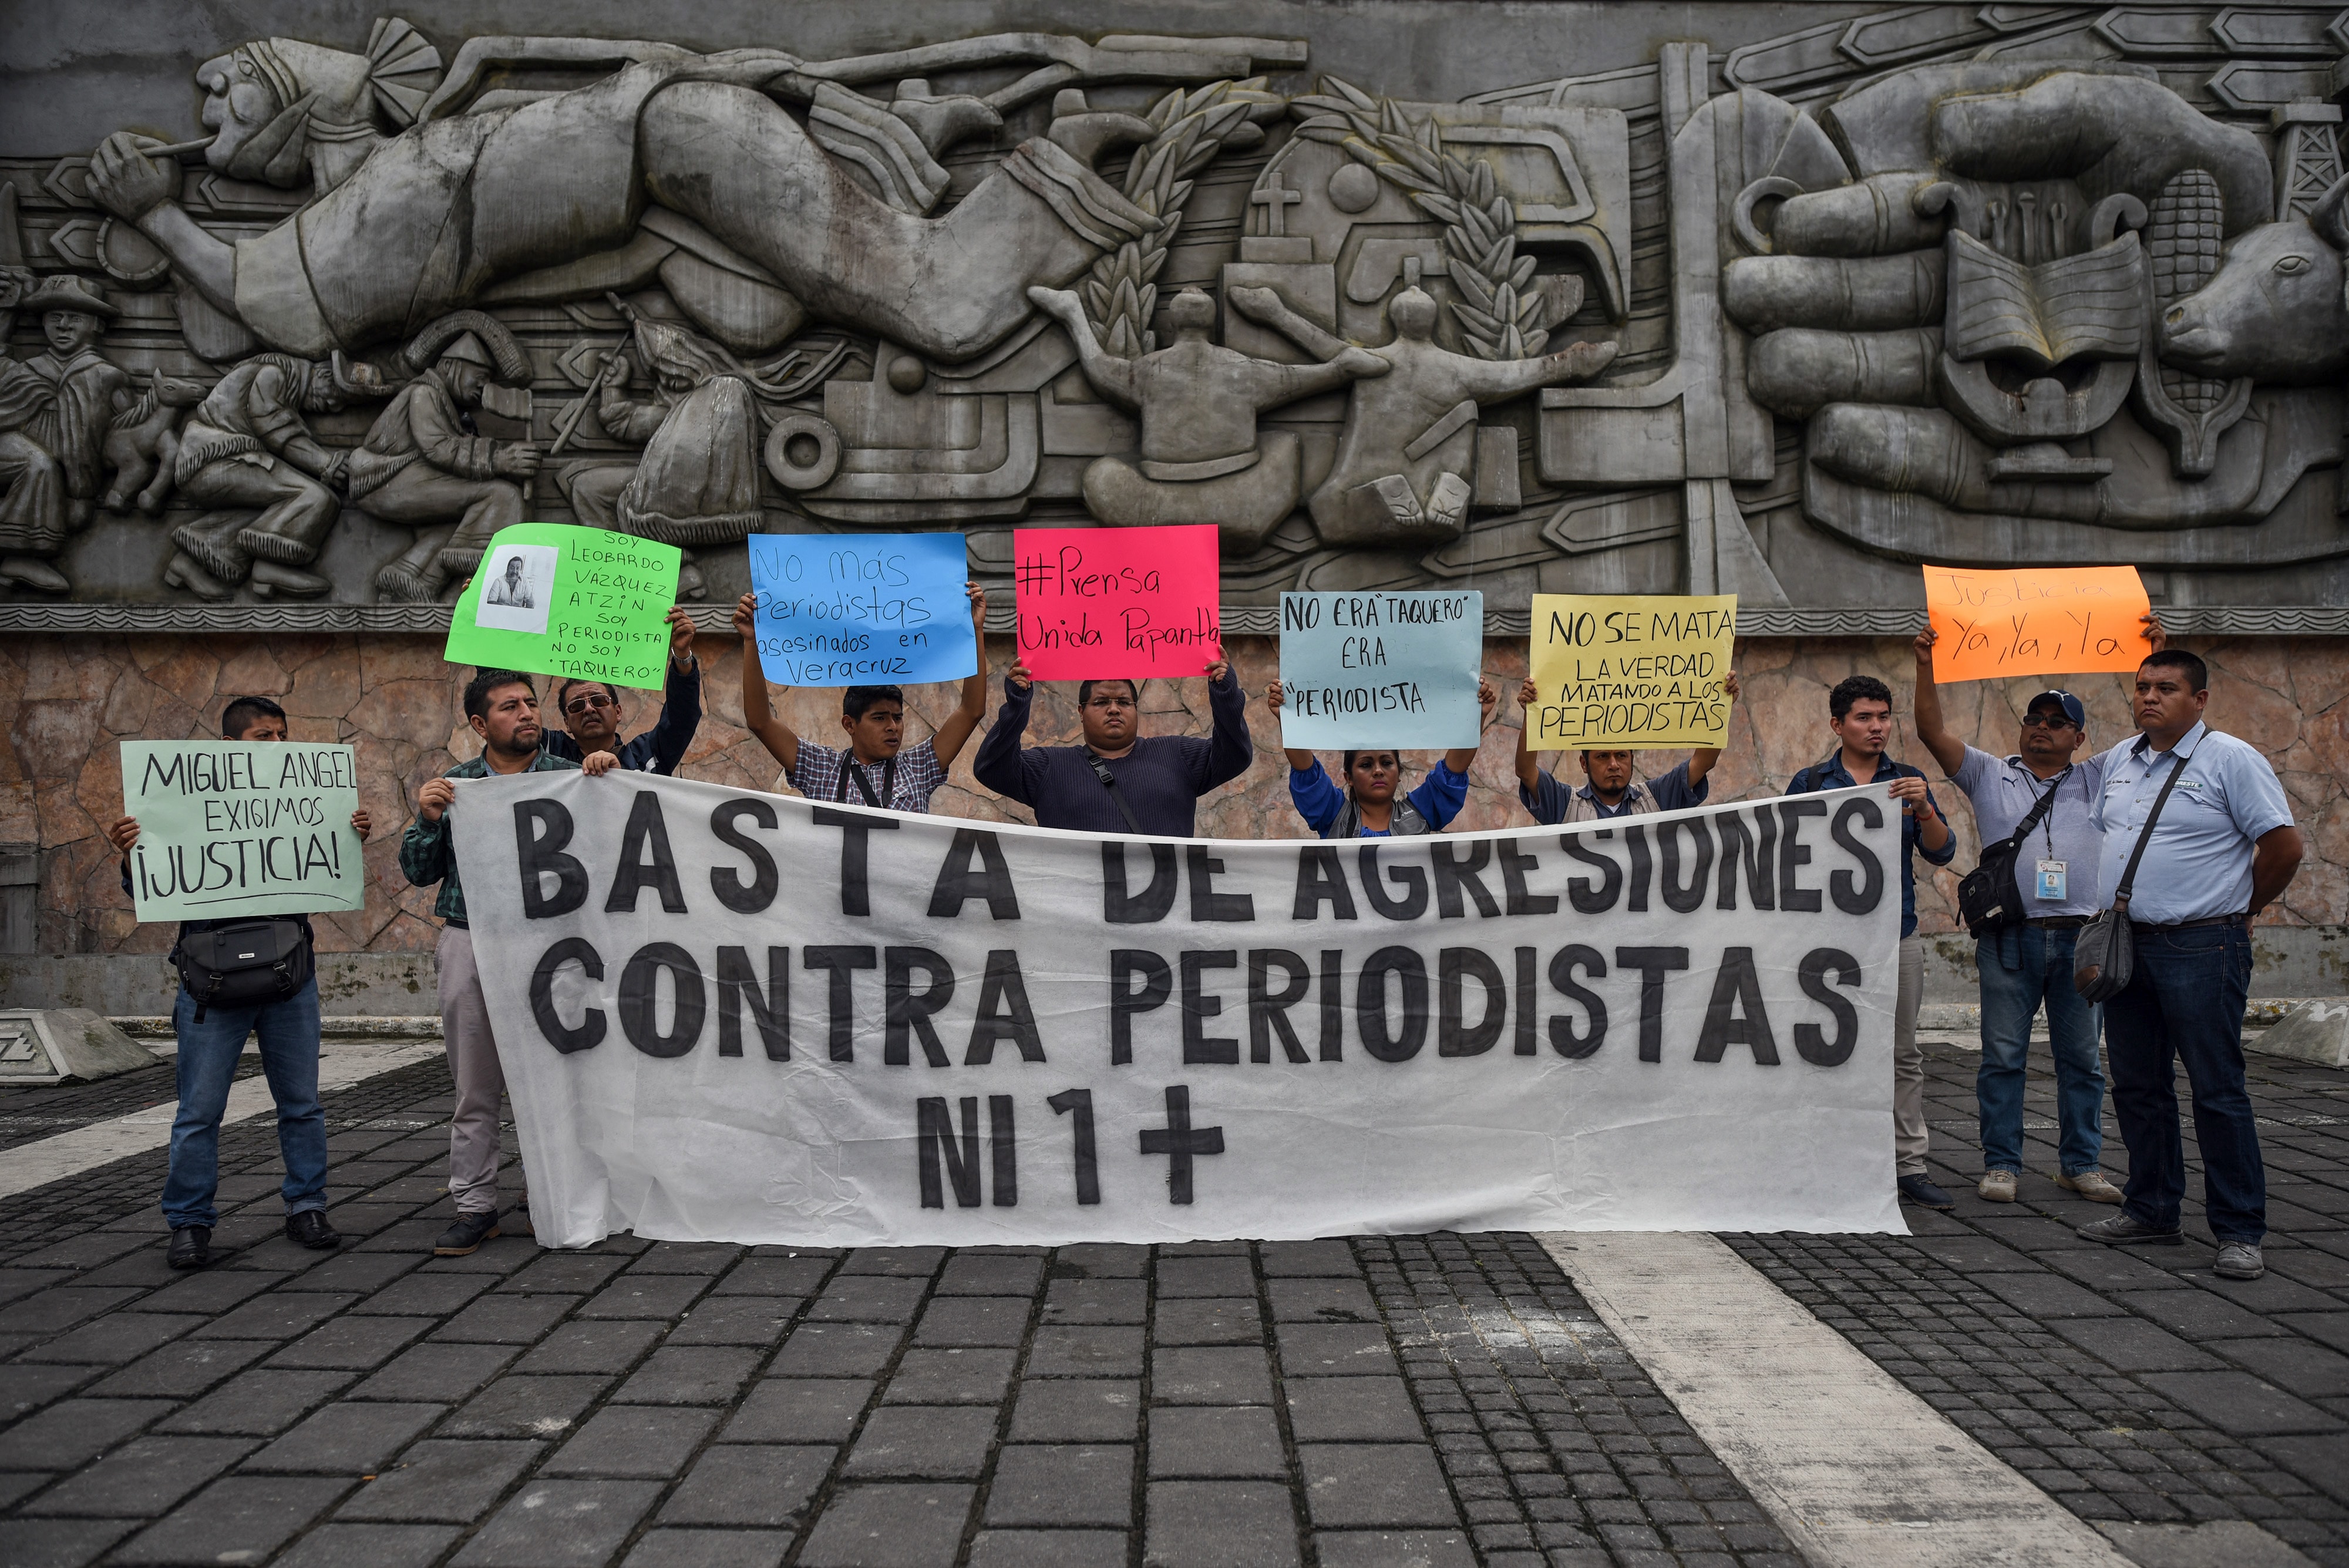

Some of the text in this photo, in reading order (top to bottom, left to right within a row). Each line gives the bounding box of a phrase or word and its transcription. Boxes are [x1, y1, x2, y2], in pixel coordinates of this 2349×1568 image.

[571, 538, 665, 571] LEOBARDO
[604, 531, 640, 548] SOY
[574, 567, 671, 600] VÁZQUEZ
[1017, 546, 1160, 597] #Prensa
[756, 586, 931, 628] Periodistas
[1936, 574, 2113, 607] Justicia
[595, 613, 628, 627] SOY
[1284, 593, 1469, 632] NO ERA "TAQUERO"
[1549, 609, 1735, 647] NO SE MATA
[551, 641, 621, 658] NO SOY
[558, 622, 662, 644] PERIODISTA
[757, 627, 928, 657] asesinados en
[1020, 606, 1219, 662] Unida Papantla
[1342, 635, 1387, 668] ERA
[2065, 610, 2126, 656] Ya
[786, 657, 913, 684] Veracruz
[1576, 652, 1714, 681] LA VERDAD
[1285, 681, 1426, 721] "PERIODISTA
[1561, 680, 1723, 703] MATANDO A LOS
[1540, 701, 1726, 739] PERIODISTAS
[141, 751, 357, 796] MIGUEL ANGEL
[204, 796, 324, 832] EXIGIMOS
[136, 831, 342, 901] ¡JUSTICIA!
[513, 790, 1884, 923] BASTA DE AGRESIONES
[529, 936, 1862, 1068] CONTRA PERIODISTAS
[917, 1084, 1225, 1210] NI 1 +
